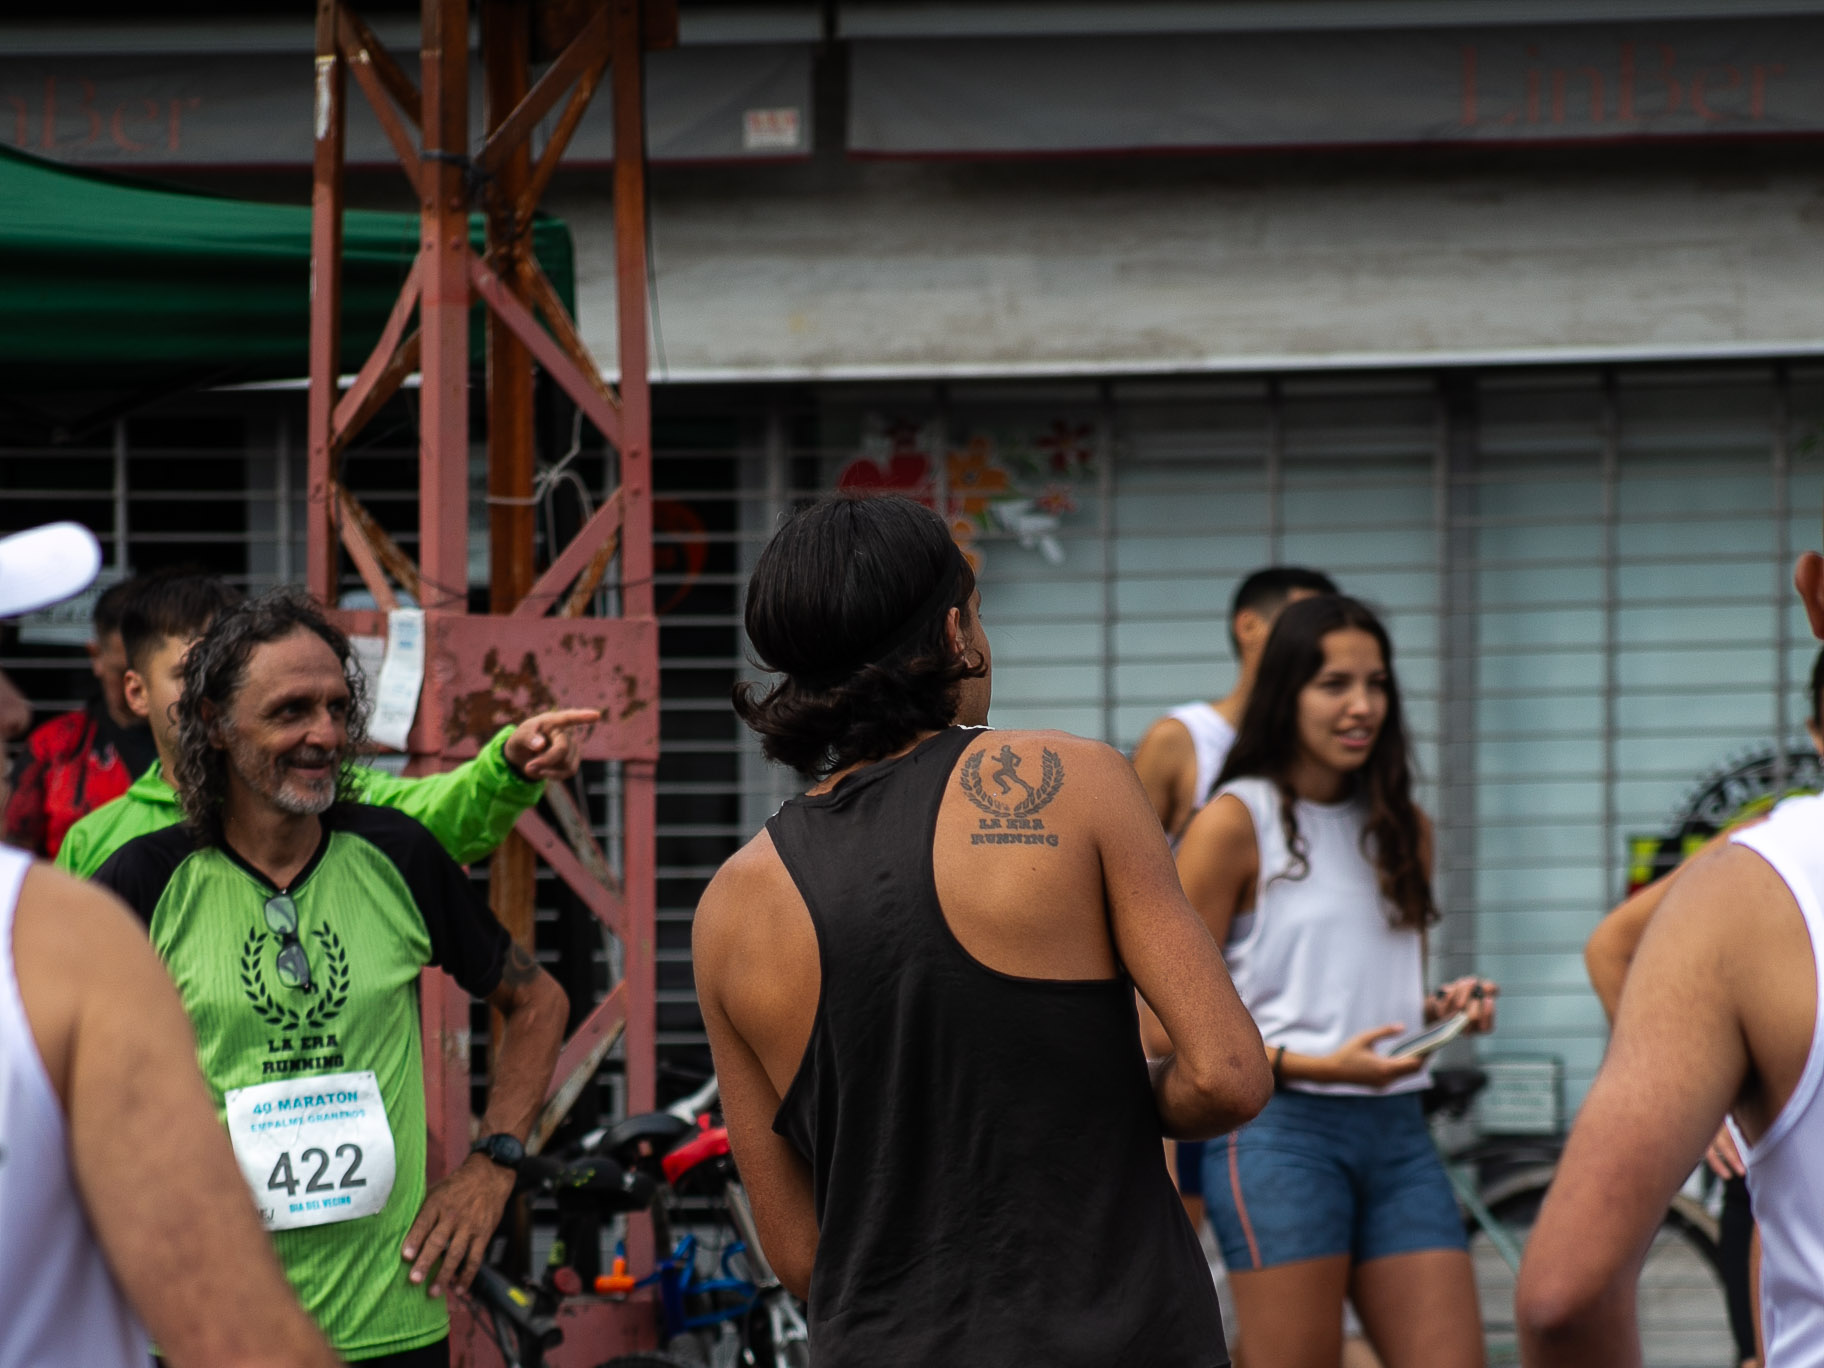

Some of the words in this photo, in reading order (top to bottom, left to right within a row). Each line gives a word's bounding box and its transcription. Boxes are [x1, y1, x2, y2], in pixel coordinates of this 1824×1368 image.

[979, 818, 1002, 829] LA
[1006, 818, 1044, 831] ERA
[970, 833, 1059, 847] RUNNING
[267, 1039, 294, 1053] LA
[301, 1034, 338, 1050] ERA
[262, 1053, 345, 1075] RUNNING
[253, 1102, 272, 1115] 40
[267, 1143, 367, 1197] 422
